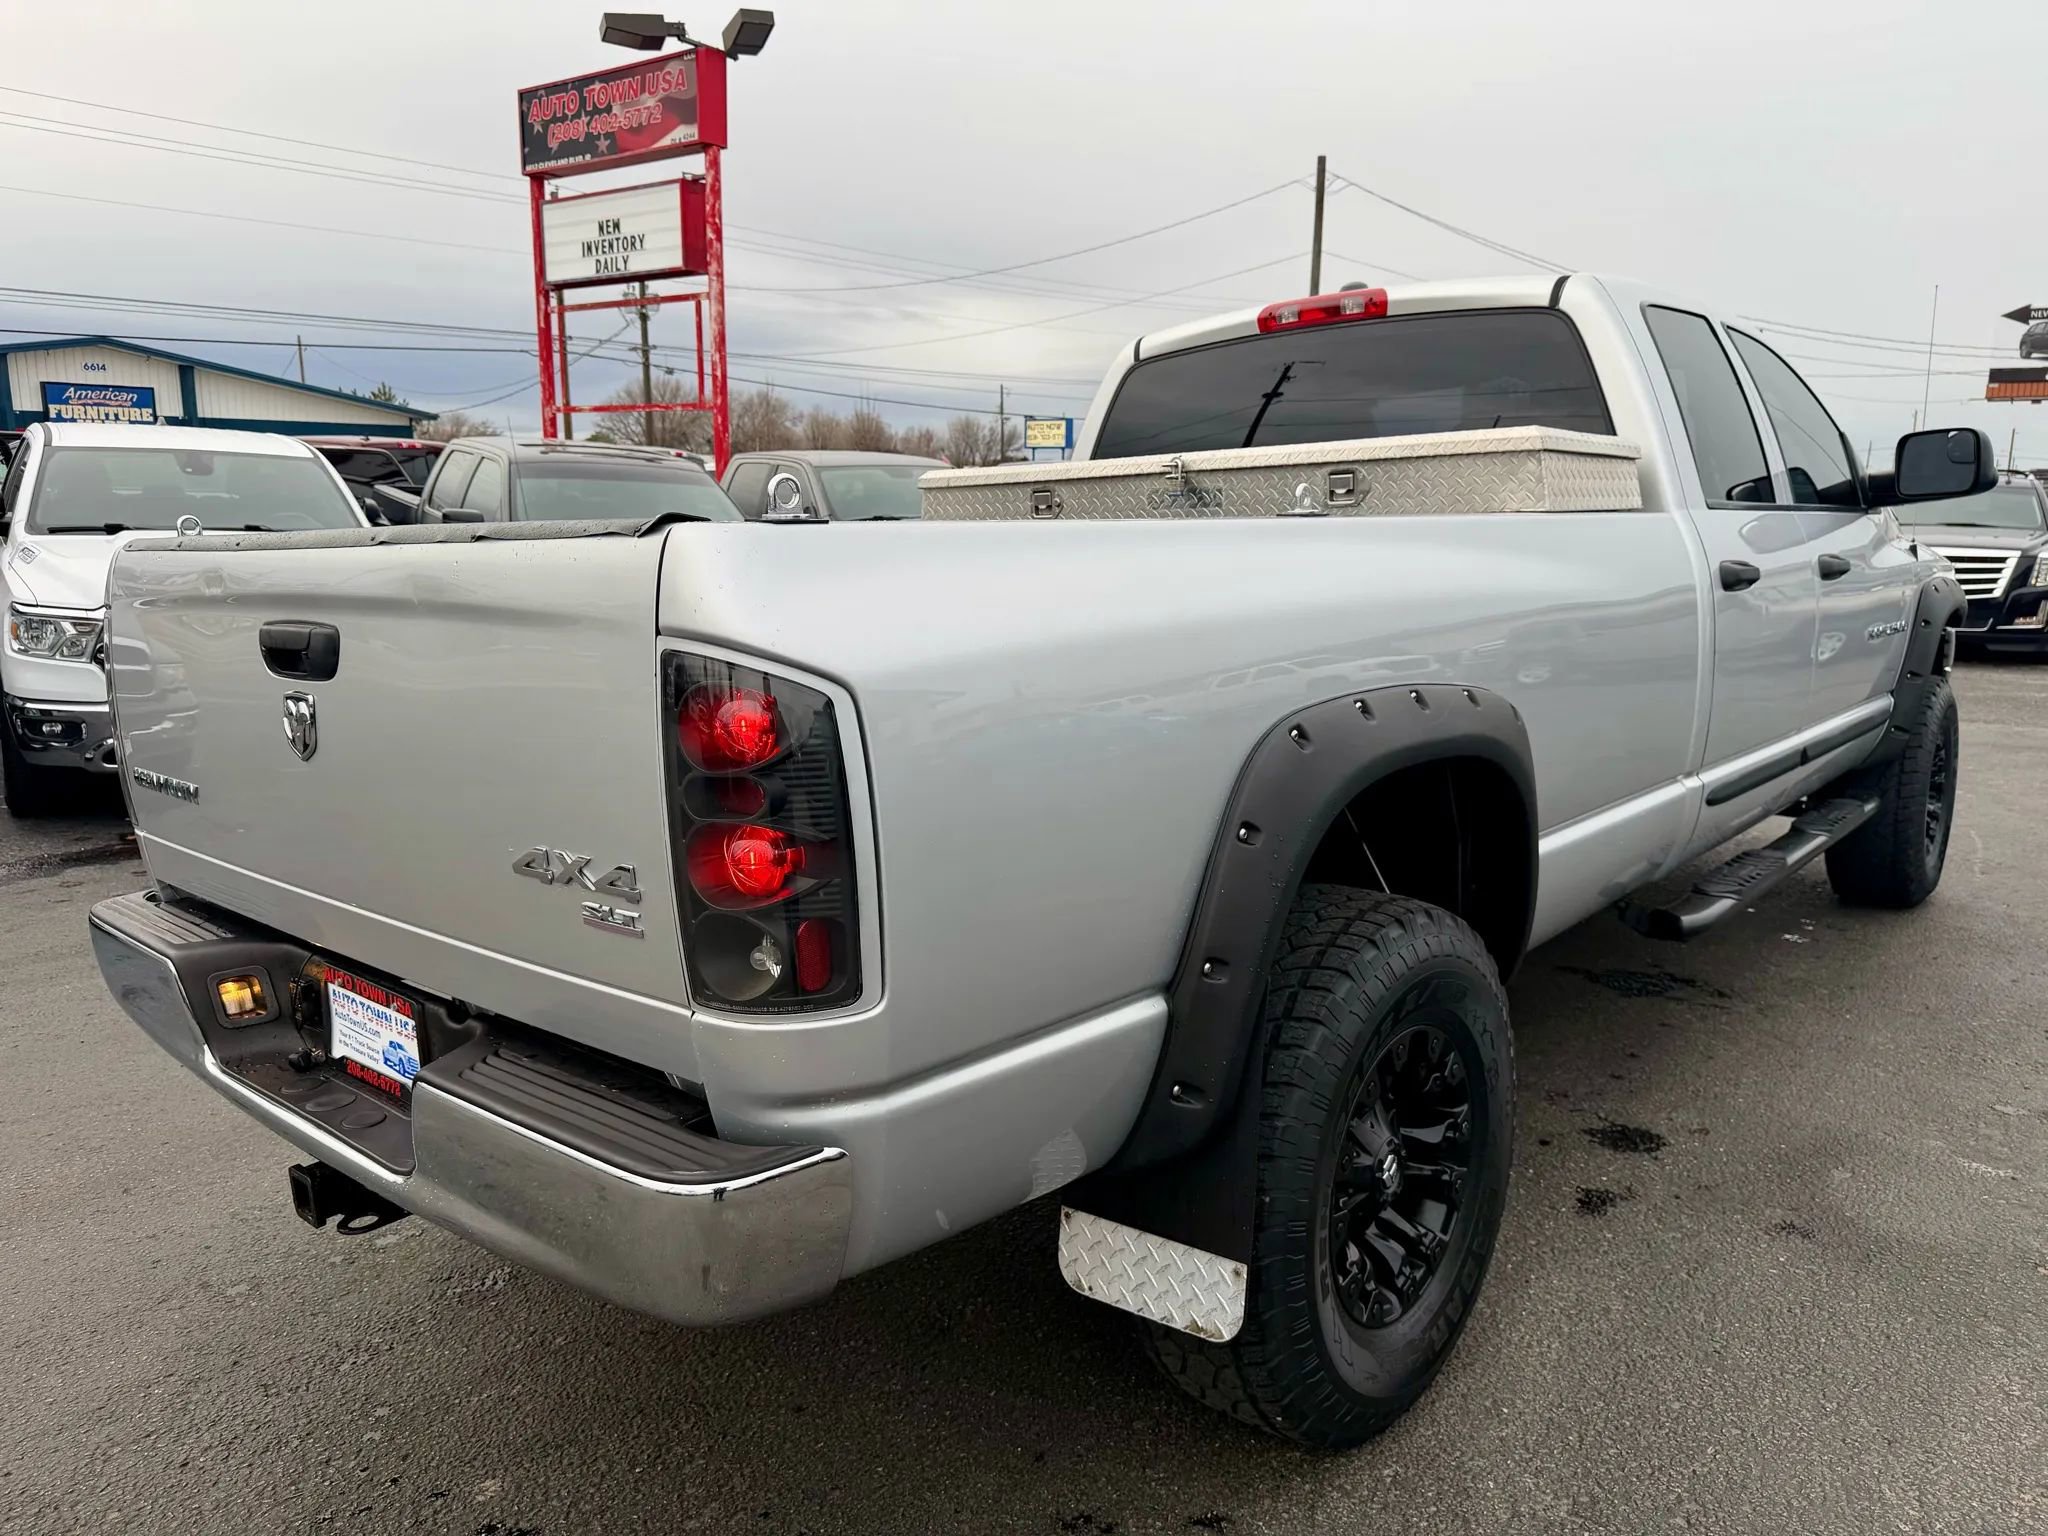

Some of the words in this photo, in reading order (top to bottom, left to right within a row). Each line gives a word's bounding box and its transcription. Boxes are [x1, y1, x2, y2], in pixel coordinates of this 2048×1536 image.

[528, 90, 579, 122] AUTO
[584, 76, 641, 111] TOWN
[645, 66, 687, 98] USA
[548, 118, 585, 147] (208)
[590, 102, 663, 135] 402-5772
[598, 218, 621, 236] NEW
[582, 234, 645, 257] INVENTORY
[595, 255, 630, 274] DAILY
[83, 362, 107, 372] 6614
[62, 387, 138, 402] American
[48, 404, 154, 422] FURNITURE
[581, 901, 642, 929] SLT
[323, 967, 353, 989] AUTO
[356, 978, 387, 1007] TOWN
[389, 993, 413, 1018] USA
[335, 1008, 381, 1039] AutoTownUS.com
[345, 1060, 401, 1096] 208-402-5772
